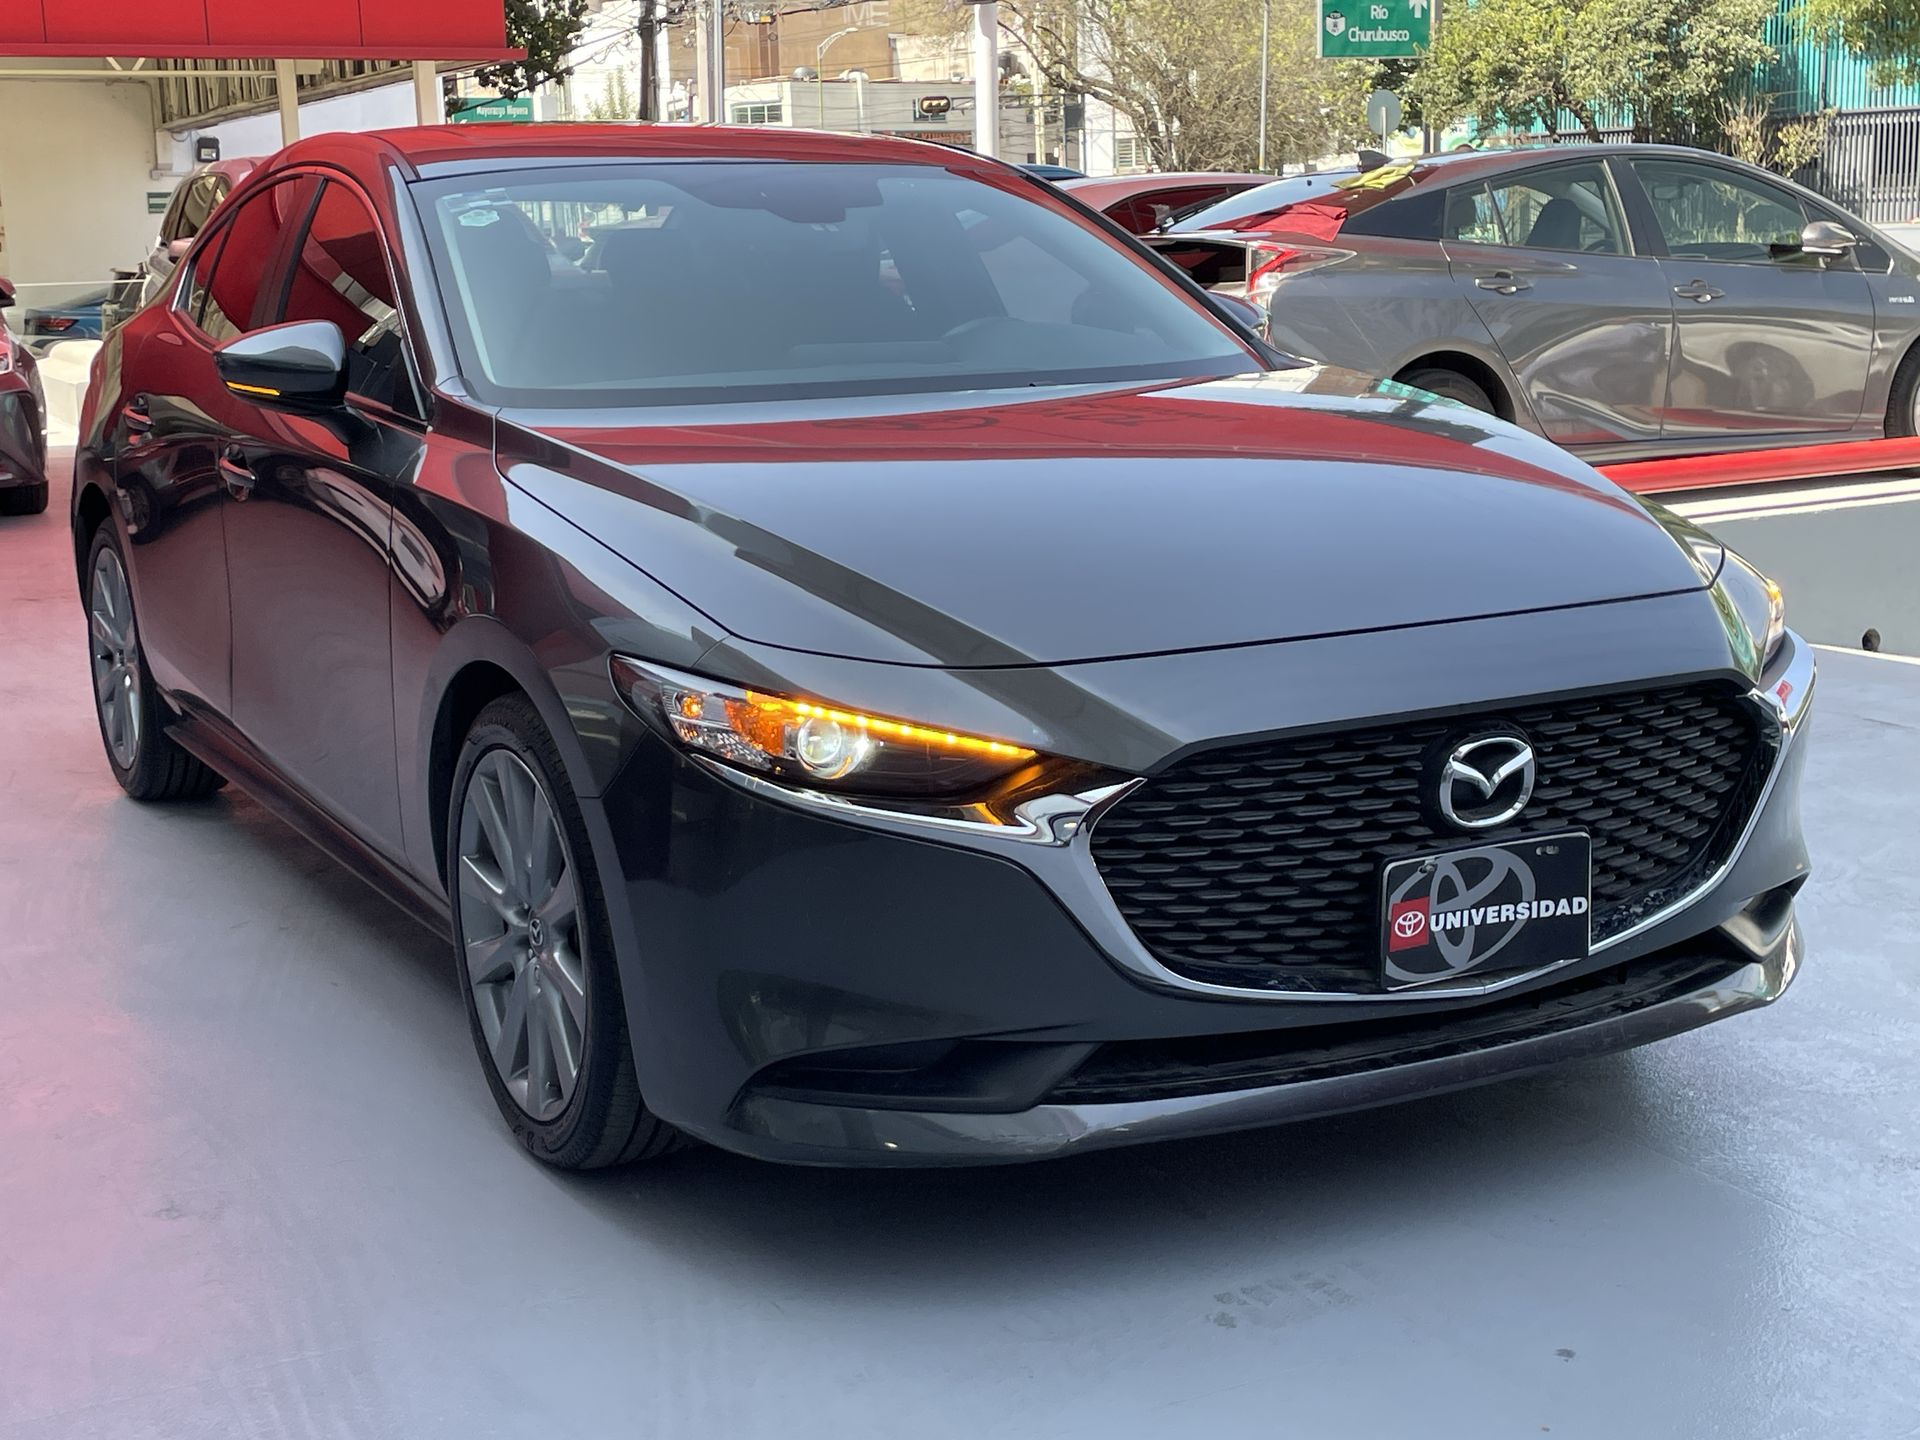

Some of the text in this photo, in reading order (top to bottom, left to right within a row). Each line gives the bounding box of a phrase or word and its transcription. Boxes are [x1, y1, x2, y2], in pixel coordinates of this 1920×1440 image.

[1370, 4, 1389, 20] Río
[1348, 26, 1410, 42] Churubusco
[1430, 896, 1588, 933] UNIVERSIDAD
